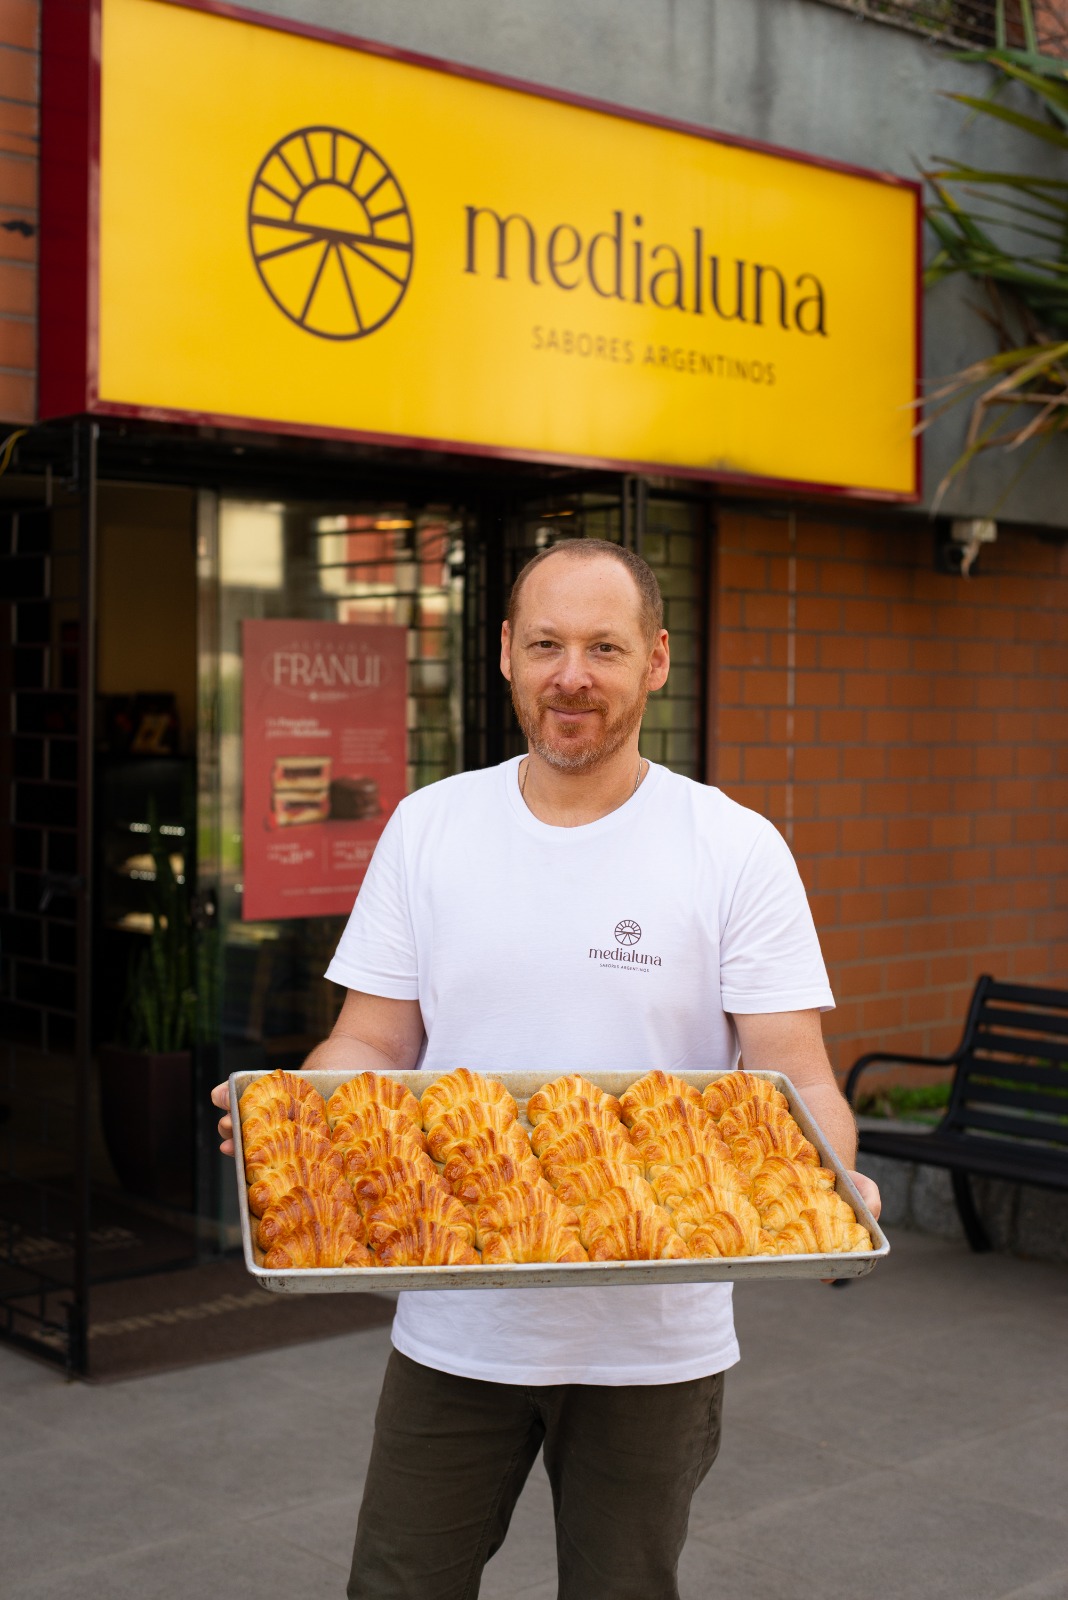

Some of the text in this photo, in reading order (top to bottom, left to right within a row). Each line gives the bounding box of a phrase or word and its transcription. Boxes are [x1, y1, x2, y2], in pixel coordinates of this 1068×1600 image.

[463, 205, 829, 337] medialuna
[531, 325, 777, 386] SABORES ARGENTINOS
[589, 947, 662, 966] medialuna
